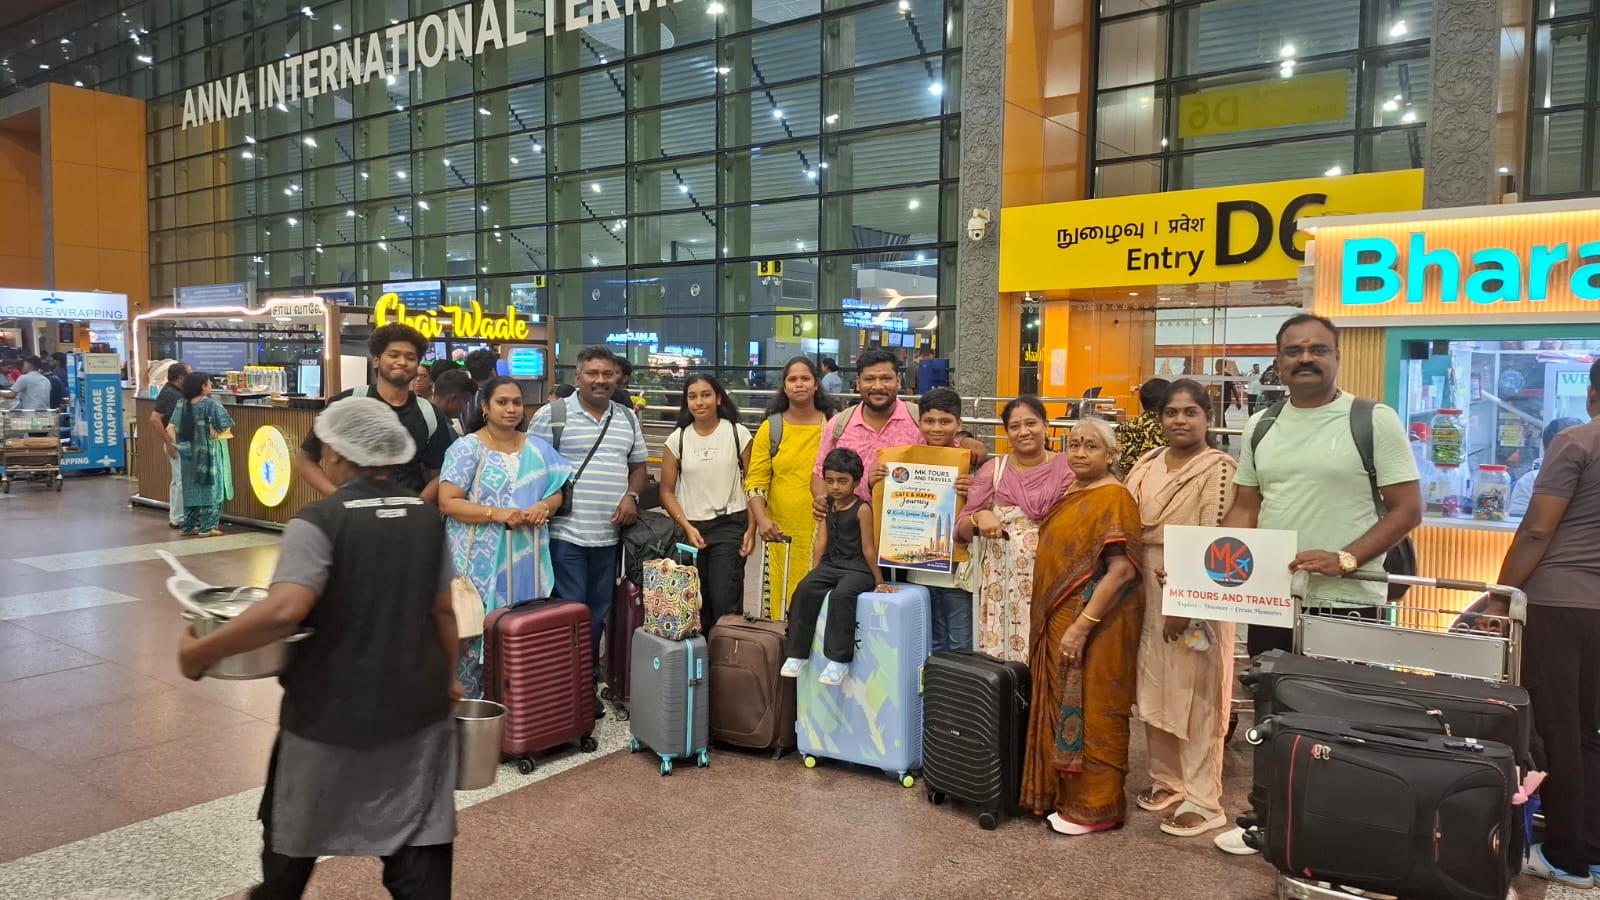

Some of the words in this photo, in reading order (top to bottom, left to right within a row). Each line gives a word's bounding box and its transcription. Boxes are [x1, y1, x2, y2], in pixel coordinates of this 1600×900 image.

[181, 72, 252, 131] ANNA
[259, 0, 527, 110] INTERNATIONAL
[1056, 221, 1145, 249] நுழைவு
[1168, 213, 1206, 234] प्रवेश
[1215, 193, 1328, 266] D6
[1126, 246, 1205, 277] Entry
[57, 307, 123, 319] WRAPPING
[441, 299, 529, 341] Waale
[93, 388, 104, 444] BAGGAGE
[106, 385, 117, 447] WRAPPING
[1209, 542, 1249, 580] MK
[1169, 589, 1184, 598] MK
[1187, 590, 1219, 600] TOURS
[1221, 593, 1243, 603] AND
[1246, 595, 1291, 607] TRAVELS
